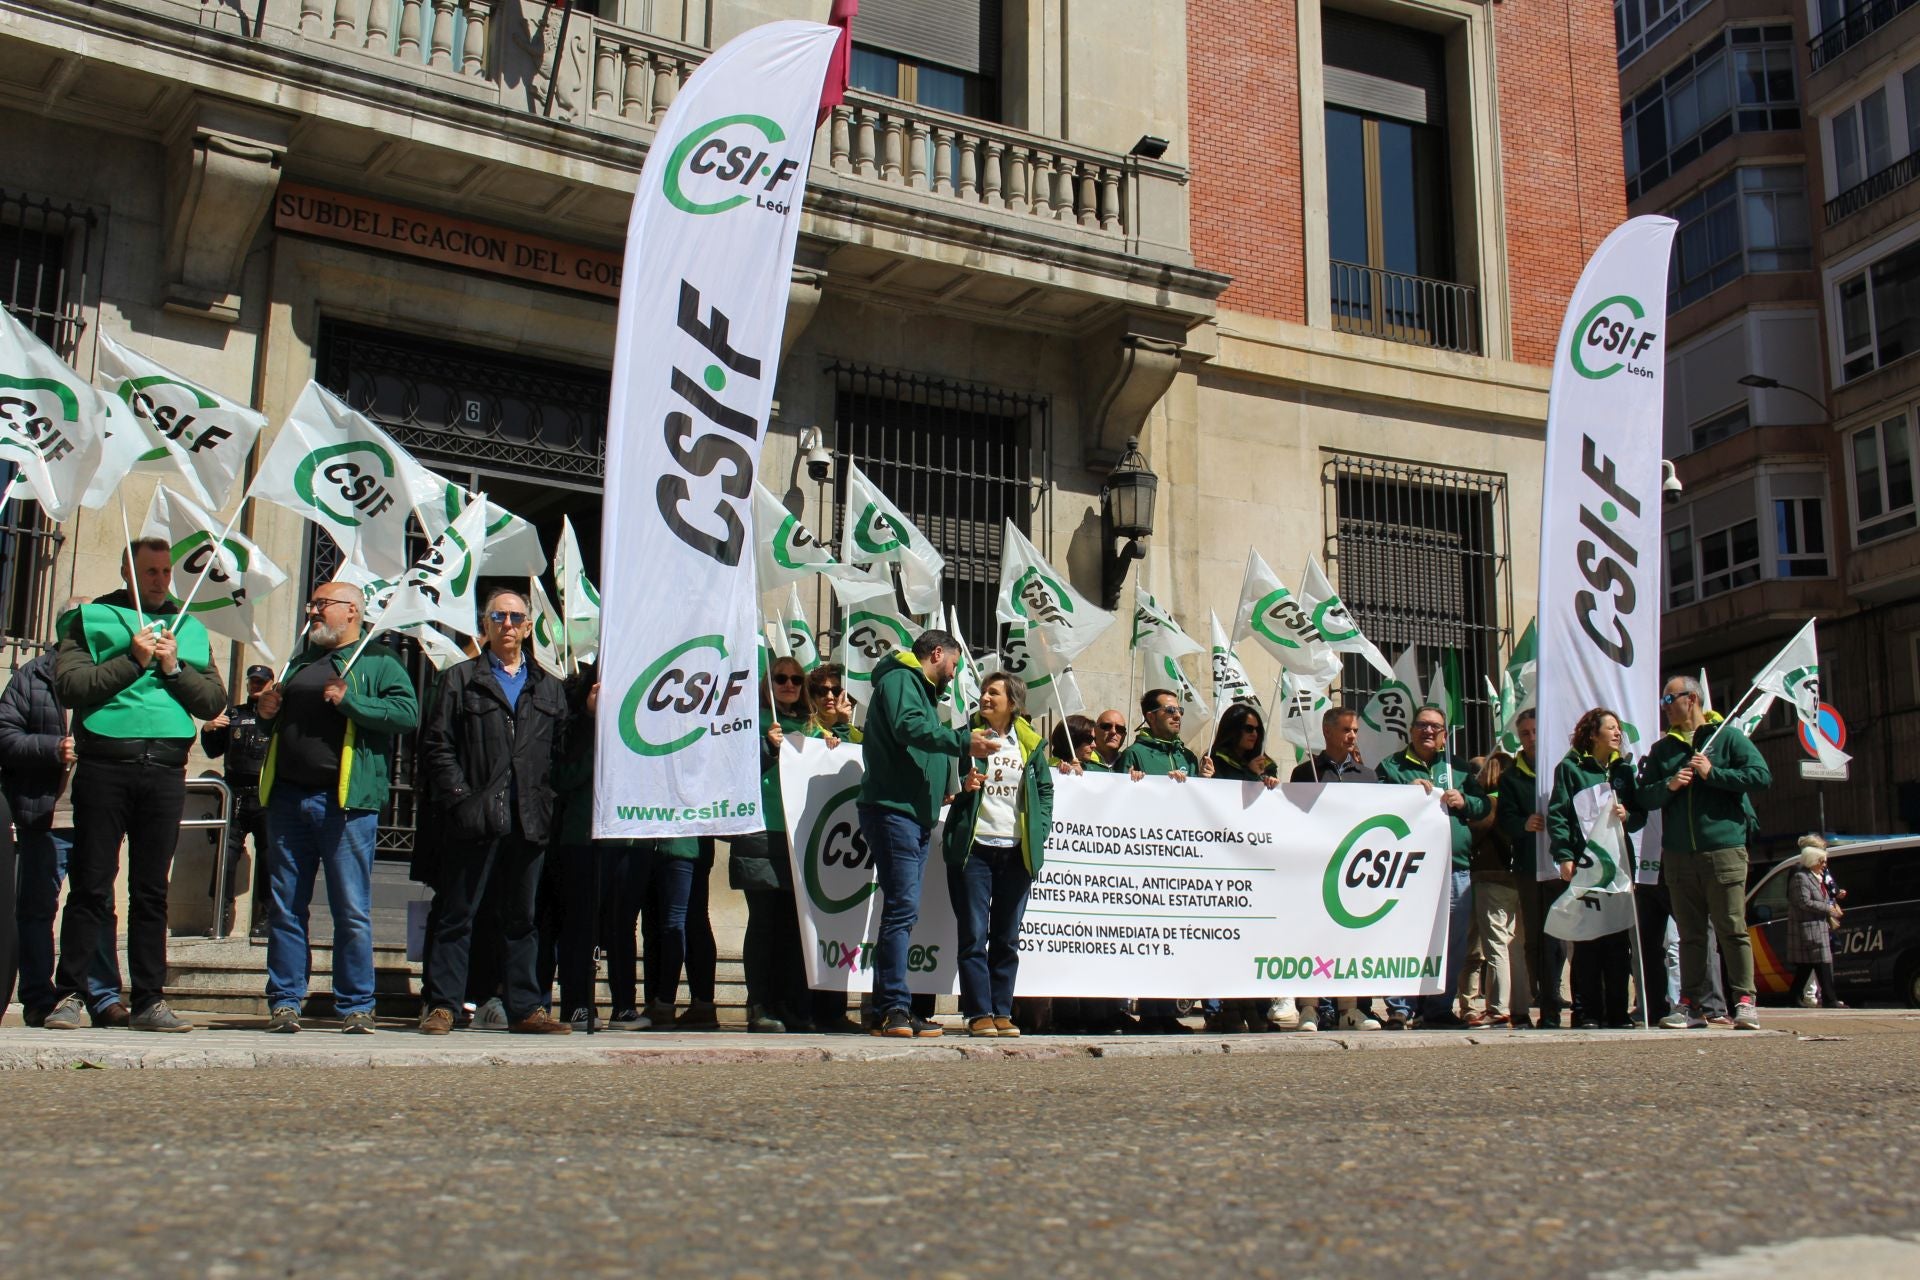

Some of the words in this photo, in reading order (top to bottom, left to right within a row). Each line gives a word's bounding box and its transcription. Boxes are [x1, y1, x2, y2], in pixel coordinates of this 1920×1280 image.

[756, 194, 791, 215] León
[280, 193, 508, 263] SUBDELEGACION
[514, 244, 566, 276] DEL
[1627, 362, 1654, 379] León
[467, 402, 479, 420] 6
[323, 463, 394, 518] CSIF
[710, 717, 753, 736] León
[616, 799, 756, 821] www.csif.es
[1066, 823, 1094, 837] PARA
[1096, 826, 1137, 839] TODAS
[1140, 827, 1163, 841] LAS
[1166, 827, 1244, 843] CATEGORÍAS
[1247, 832, 1273, 846] QUE
[1056, 838, 1070, 852] LA
[1071, 840, 1121, 855] CALIDAD
[1124, 843, 1204, 858] ASISTENCIAL.
[1345, 848, 1426, 888] CSIF
[1085, 874, 1139, 890] PARCIAL,
[1142, 877, 1214, 891] ANTICIPADA
[1215, 880, 1223, 891] Y
[1227, 880, 1253, 892] POR
[1068, 890, 1100, 904] PARA
[1102, 892, 1165, 906] PERSONAL
[1169, 894, 1252, 908] ESTATUTARIO.
[1019, 920, 1092, 937] ADECUACIÓN
[1096, 926, 1160, 939] INMEDIATA
[1163, 927, 1177, 939] DE
[1180, 924, 1240, 940] TÉCNICOS
[1036, 939, 1044, 952] Y
[1047, 940, 1117, 954] SUPERIORES
[1120, 942, 1134, 955] AL
[1152, 943, 1160, 955] Y
[1163, 944, 1174, 956] B.
